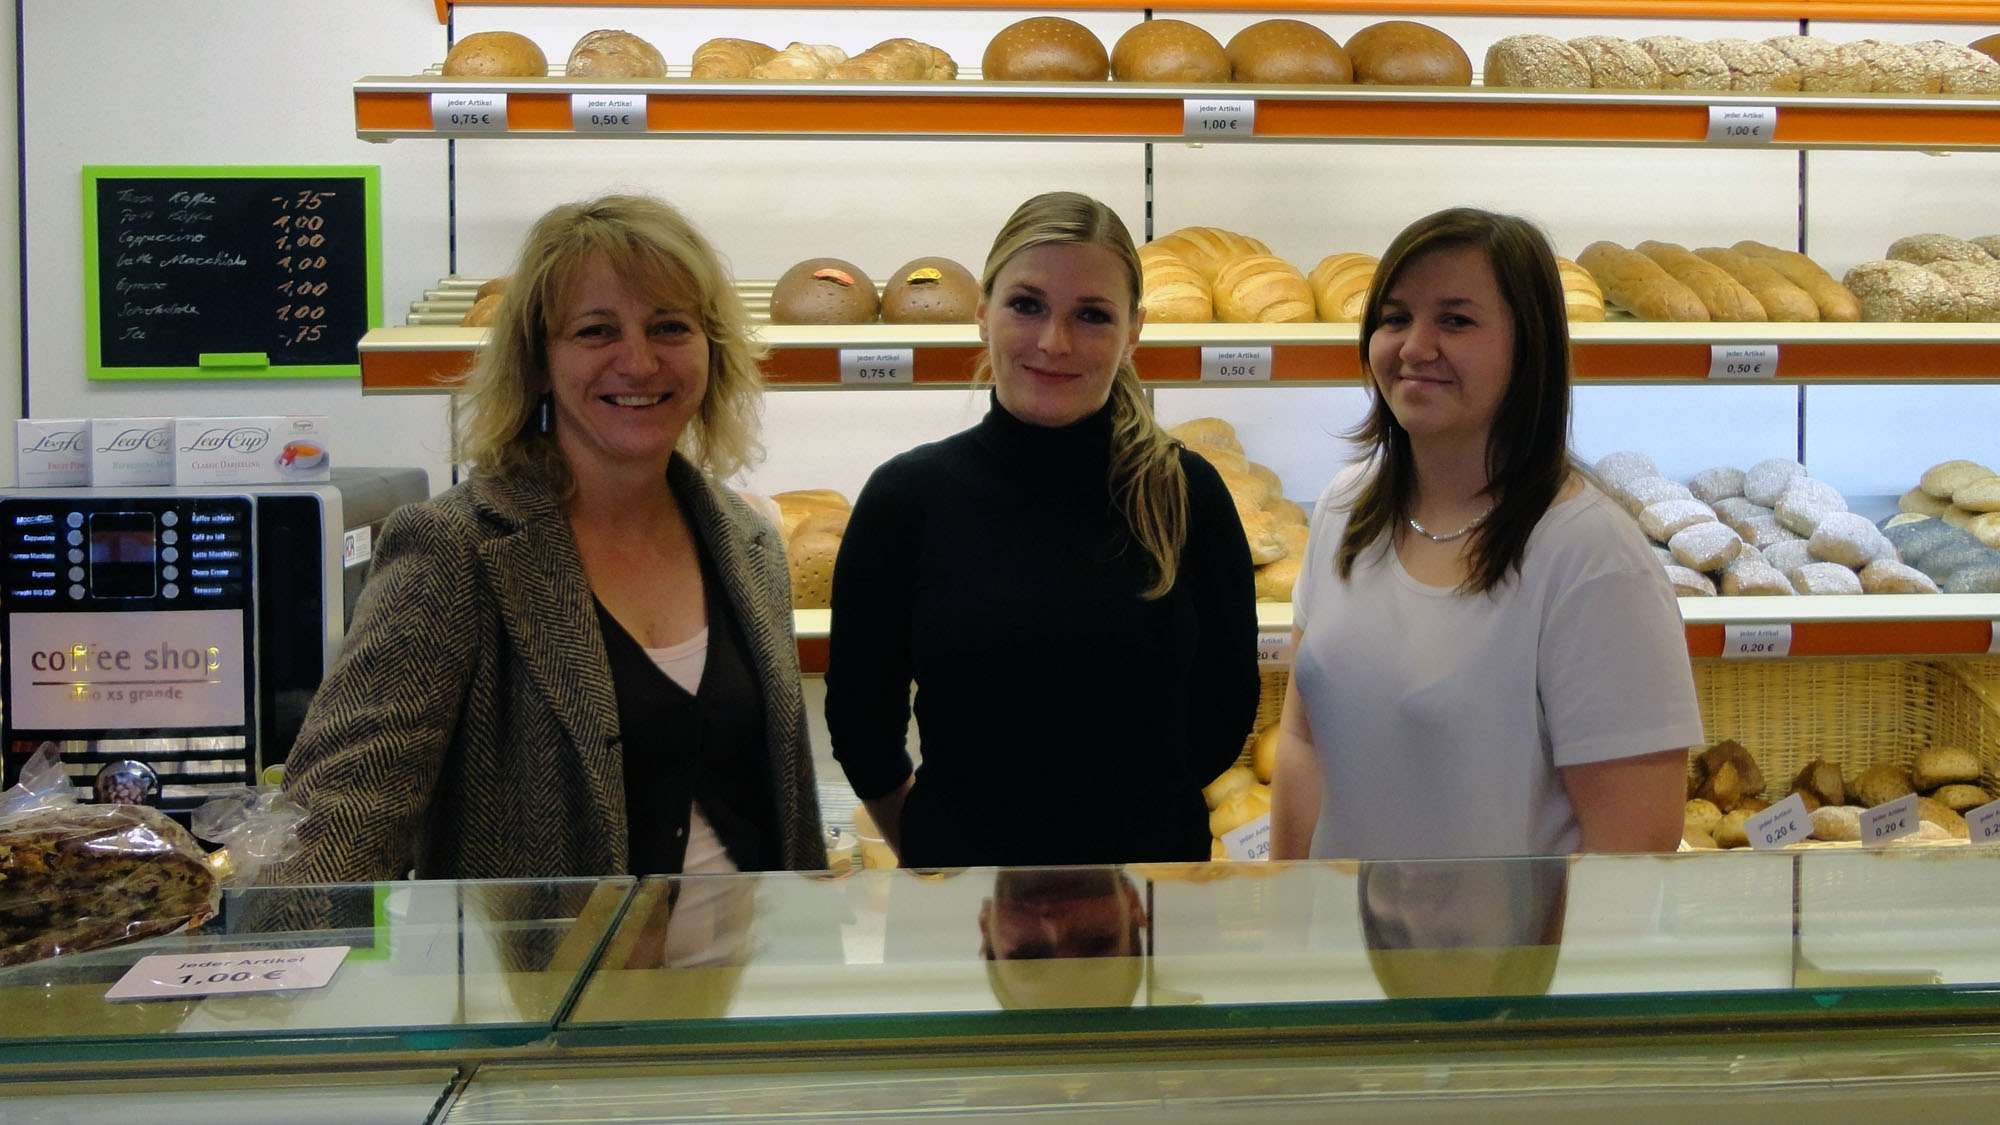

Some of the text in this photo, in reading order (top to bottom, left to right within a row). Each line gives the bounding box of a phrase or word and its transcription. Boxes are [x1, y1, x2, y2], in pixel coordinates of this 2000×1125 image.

[447, 99, 466, 107] jeder
[588, 100, 607, 108] jeder
[1199, 104, 1241, 112] jeder Artikel
[451, 113, 490, 125] 0,75 €
[592, 114, 630, 126] 0,50 €
[1203, 119, 1238, 130] 1,00 €
[1726, 125, 1761, 136] 1,00 €
[857, 354, 875, 363] jeder
[1218, 352, 1235, 360] jeder
[1726, 350, 1743, 358] jeder
[860, 368, 896, 379] 0,75 €
[1220, 366, 1256, 376] 0,50 €
[1727, 363, 1761, 374] 0,50 €
[179, 426, 269, 454] LeafCup
[1741, 643, 1775, 653] 0,20 €
[144, 641, 222, 675] shop
[1271, 650, 1280, 660] €
[106, 691, 123, 701] xs
[1766, 820, 1797, 844] 0,20 €
[1875, 819, 1906, 837] 0,20 €
[178, 957, 305, 969] jeder Artikel
[179, 970, 288, 985] 1,00 €
